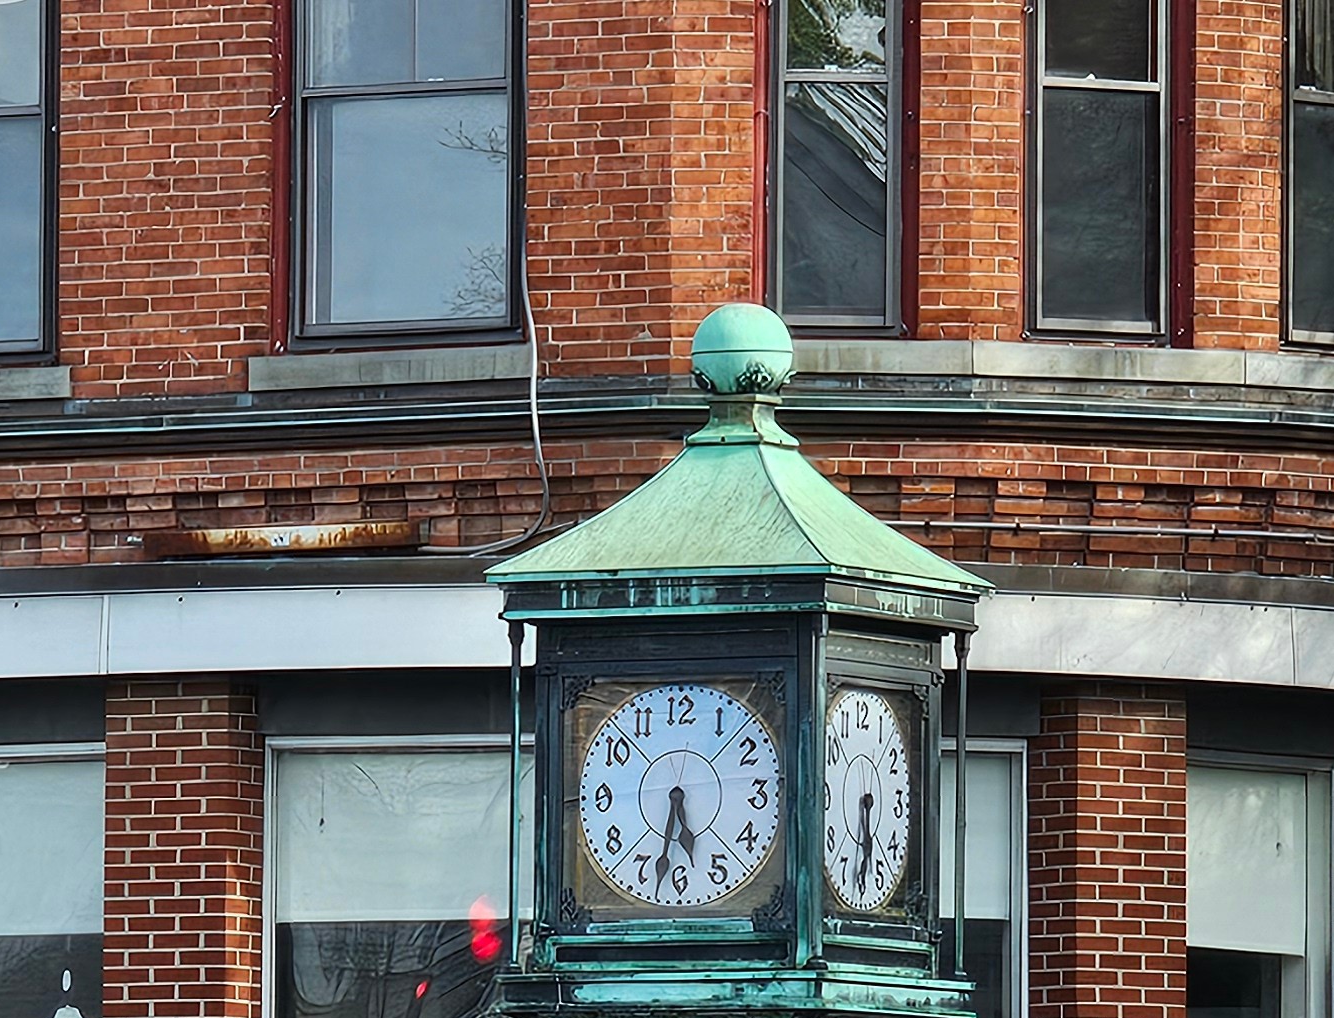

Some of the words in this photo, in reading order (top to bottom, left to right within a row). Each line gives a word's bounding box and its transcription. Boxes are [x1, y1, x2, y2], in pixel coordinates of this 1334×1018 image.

[634, 707, 652, 738] 11
[666, 694, 696, 725] 12
[715, 707, 724, 737] 1
[841, 710, 849, 738] 11
[856, 700, 870, 730] 12
[878, 715, 883, 744] 1
[605, 735, 631, 767] 10
[739, 737, 758, 767] 2
[828, 735, 840, 766] 10
[889, 748, 898, 775] 2
[595, 782, 613, 812] 9
[747, 778, 768, 810] 3
[893, 790, 903, 819] 3
[605, 825, 623, 855] 8
[735, 821, 759, 854] 4
[826, 826, 835, 853] 8
[887, 830, 898, 861] 4
[633, 854, 651, 885] 7
[672, 866, 688, 896] 6
[708, 854, 728, 885] 5
[840, 856, 848, 886] 7
[875, 859, 884, 890] 5
